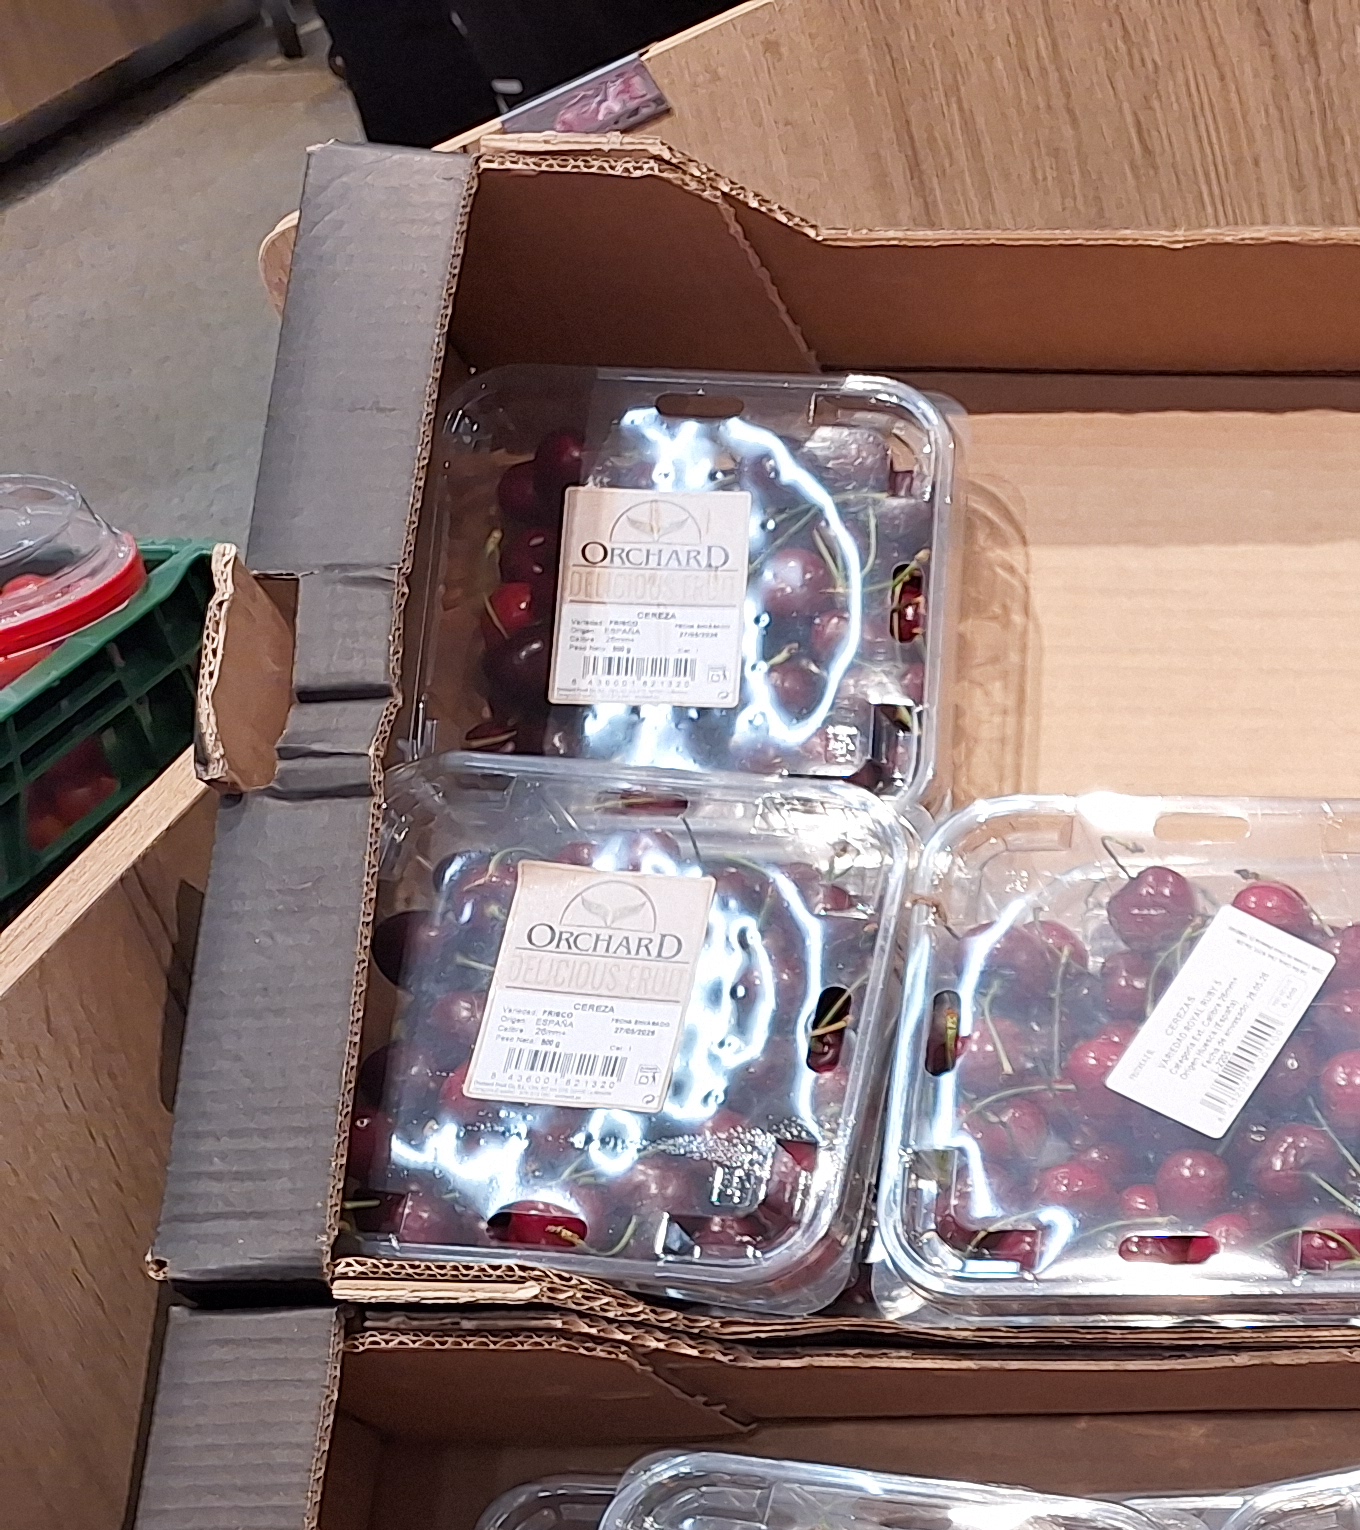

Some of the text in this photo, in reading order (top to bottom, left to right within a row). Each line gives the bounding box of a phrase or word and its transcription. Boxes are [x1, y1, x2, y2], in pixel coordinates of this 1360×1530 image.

[580, 541, 730, 568] ORCHARD
[524, 922, 685, 960] ORCHARD
[506, 953, 621, 991] DELICIOUS
[572, 1002, 615, 1013] CEREZA
